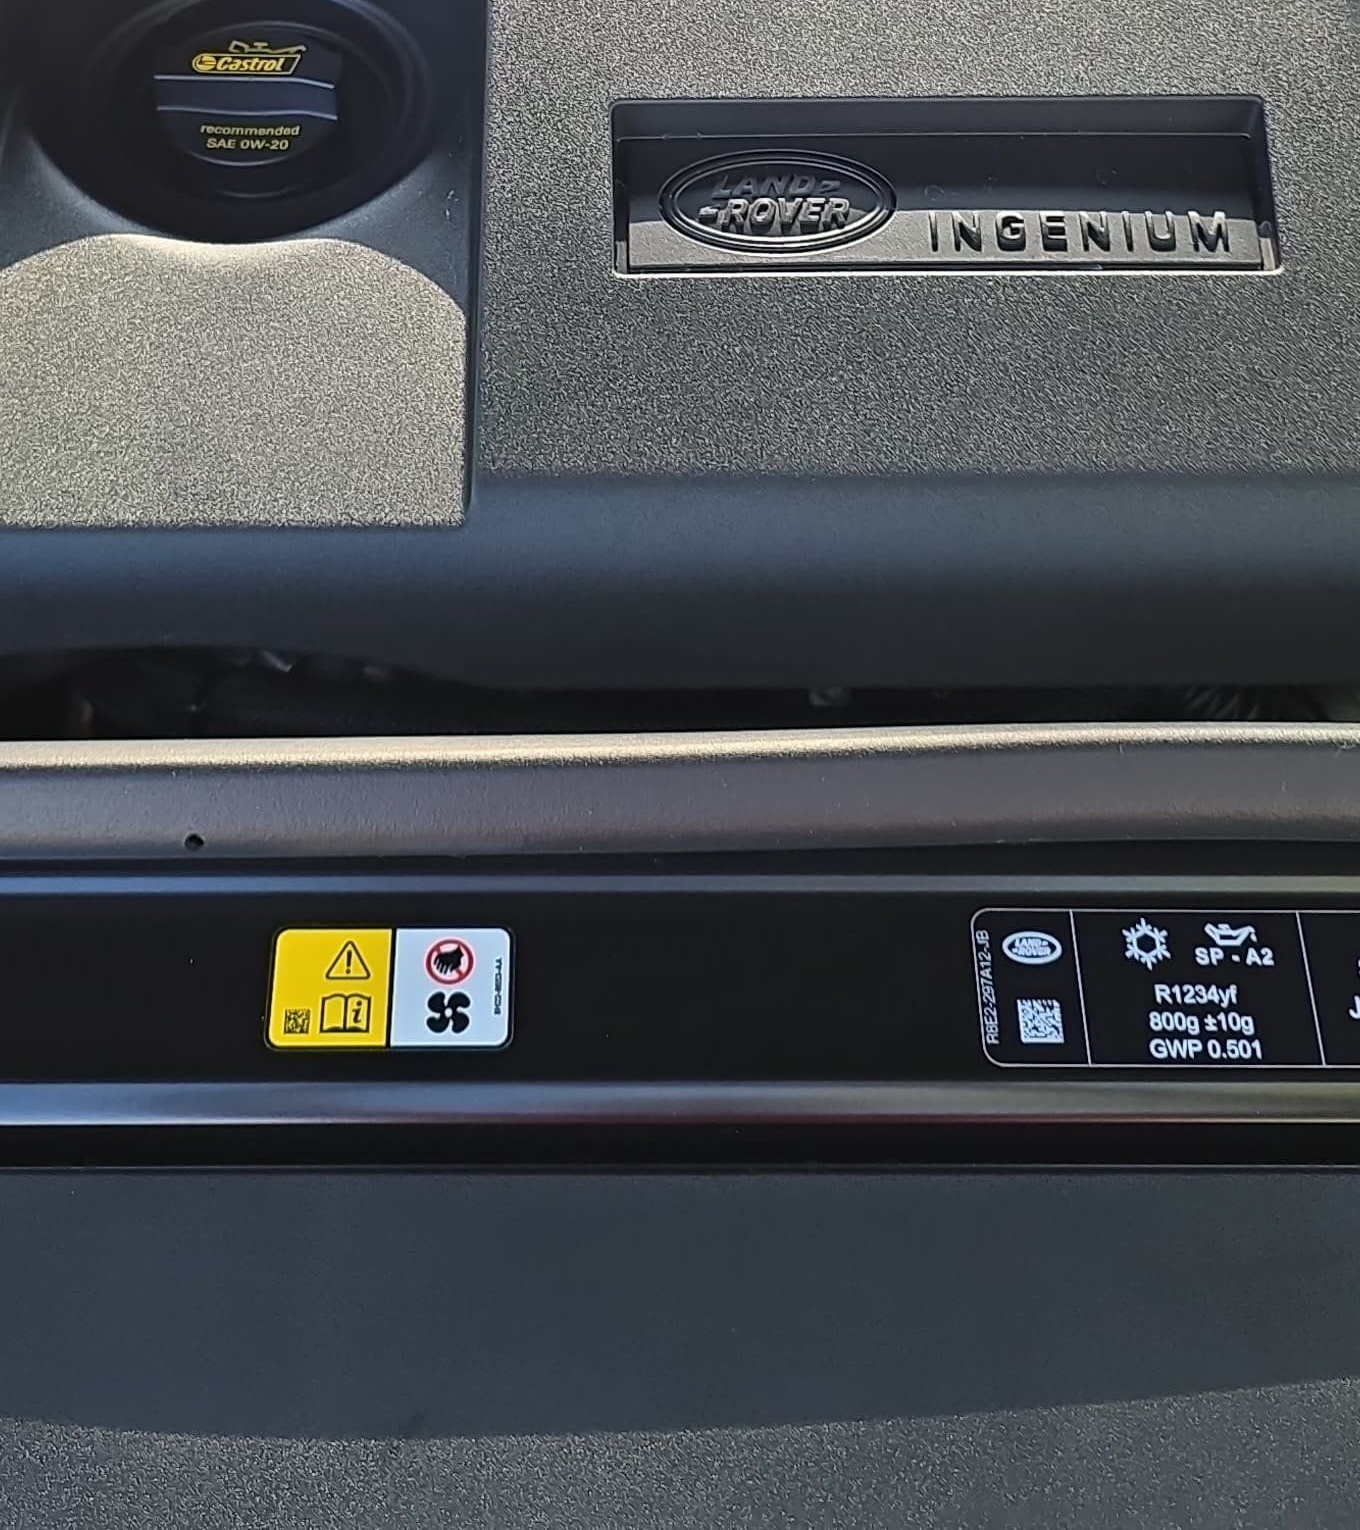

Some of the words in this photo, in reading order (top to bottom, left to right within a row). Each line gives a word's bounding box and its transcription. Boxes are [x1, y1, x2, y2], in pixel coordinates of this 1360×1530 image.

[216, 57, 285, 71] Castrol
[200, 125, 300, 136] recommended
[206, 138, 237, 149] SAE
[240, 139, 289, 150] 0W-20
[711, 172, 818, 200] LAND
[720, 197, 851, 233] ROVER
[928, 211, 1232, 254] INGENIUM
[1195, 947, 1224, 966] SP
[1245, 947, 1275, 966] A2
[1155, 984, 1238, 1008] R1234yf
[1149, 1012, 1200, 1034] 800g
[1149, 1039, 1203, 1059] GWP
[1207, 1039, 1263, 1060] 0.501
